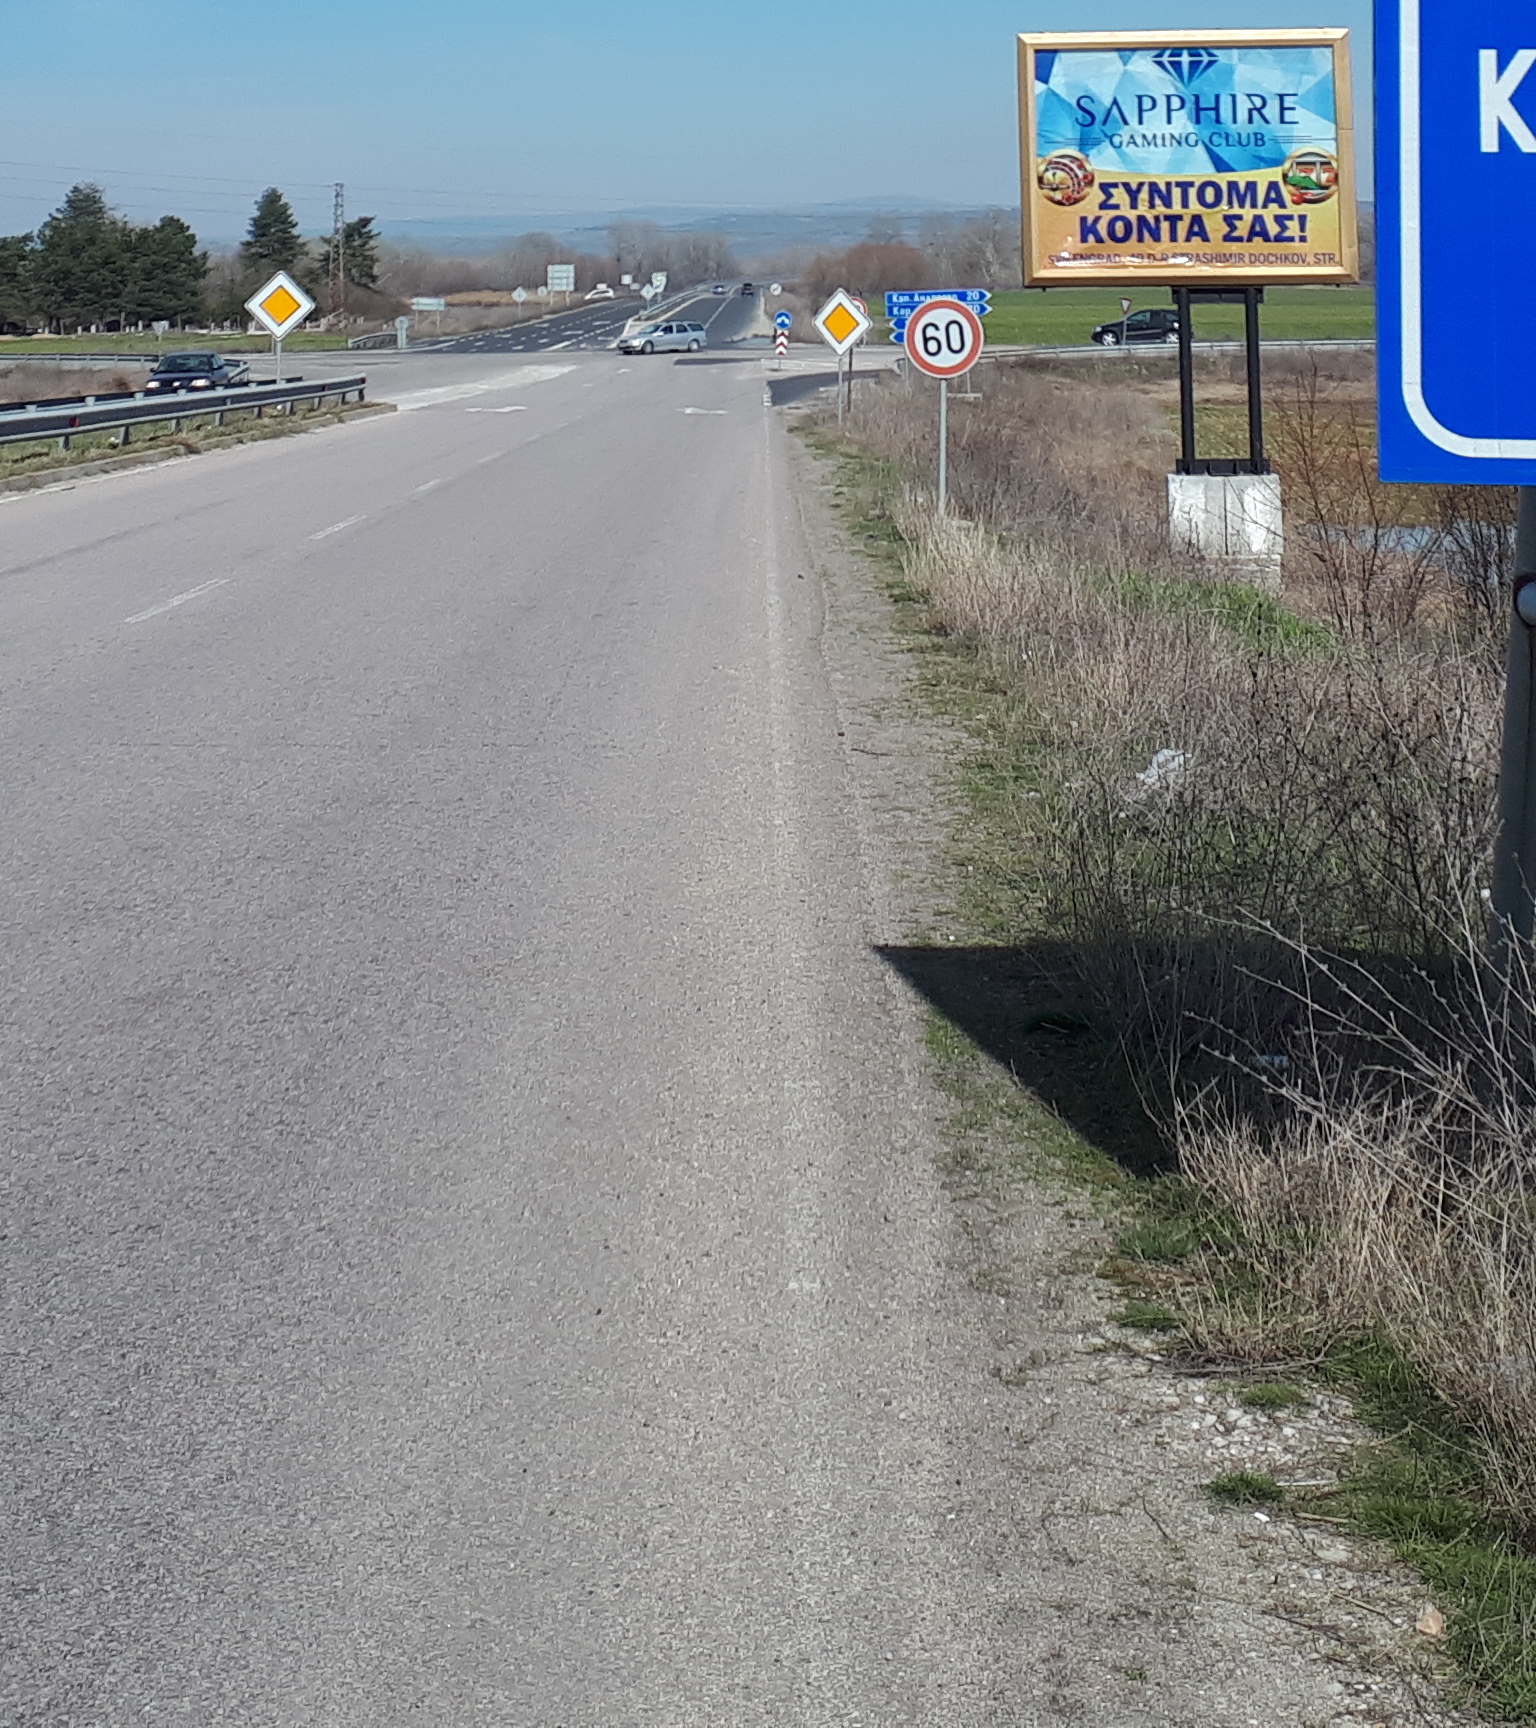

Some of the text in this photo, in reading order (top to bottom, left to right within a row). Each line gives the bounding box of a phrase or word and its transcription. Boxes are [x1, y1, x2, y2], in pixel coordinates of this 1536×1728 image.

[1074, 92, 1300, 128] SAPPHIRE
[1108, 131, 1266, 149] GAMING CLUB
[1097, 180, 1288, 211] ΣΥΝΤΟΜΑ
[1078, 213, 1309, 245] ΚΟΝΤΑ ΣΑΣ!
[1248, 252, 1311, 266] DOCHKOV,
[922, 319, 966, 357] 60
